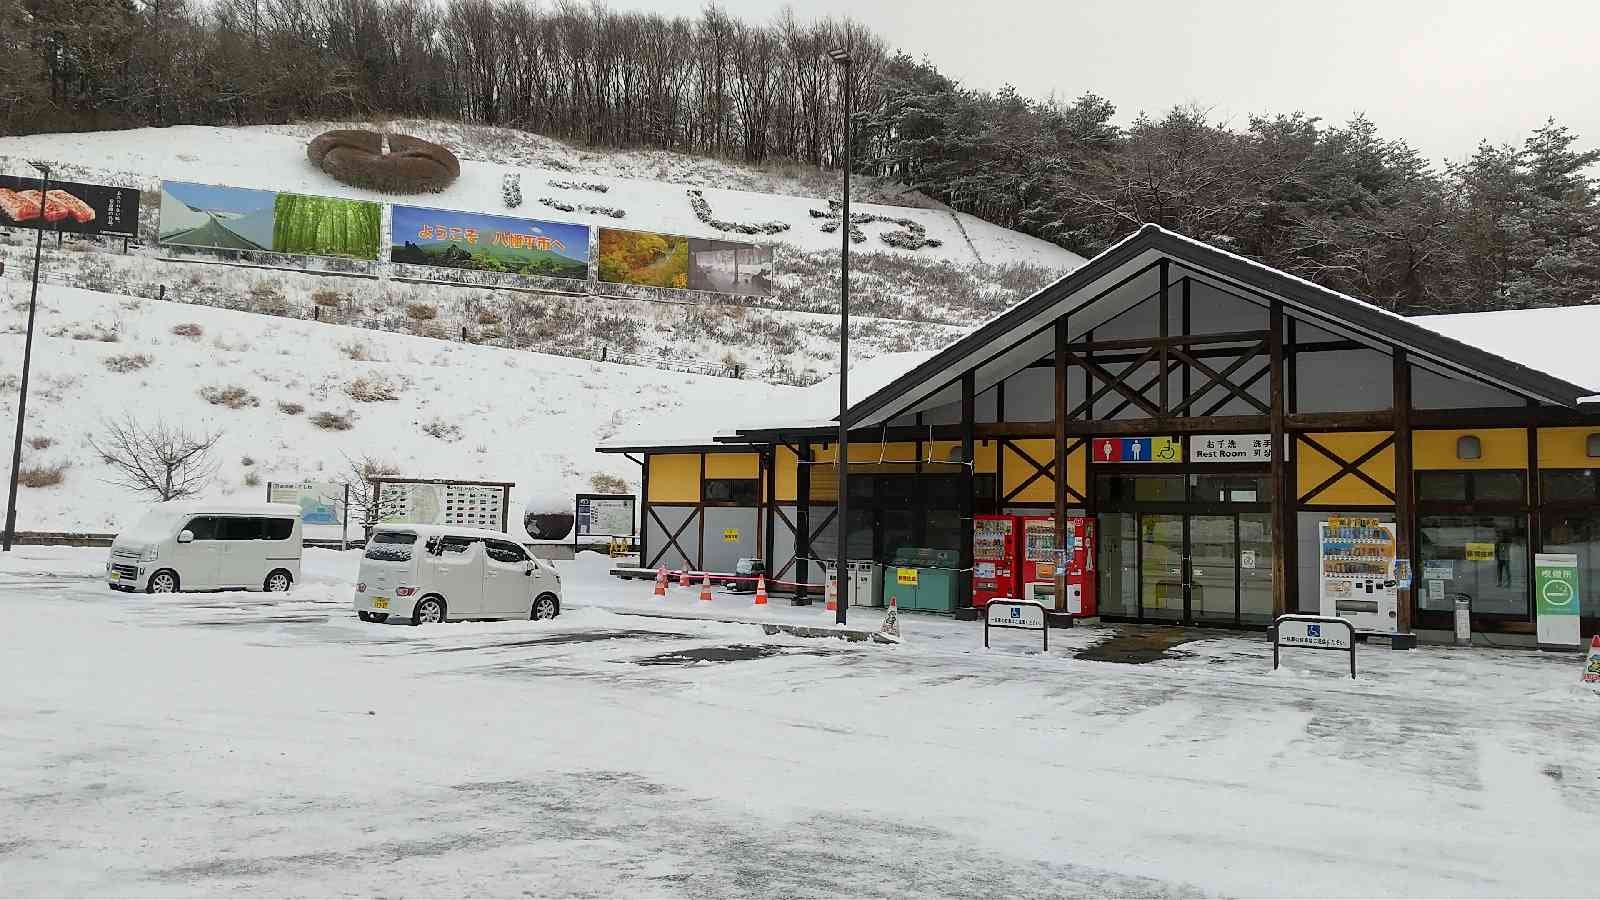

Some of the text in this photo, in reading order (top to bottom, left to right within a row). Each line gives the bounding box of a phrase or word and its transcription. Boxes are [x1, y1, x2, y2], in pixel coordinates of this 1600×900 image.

[418, 223, 480, 245] ようこそ
[1197, 450, 1247, 458] Rest Room
